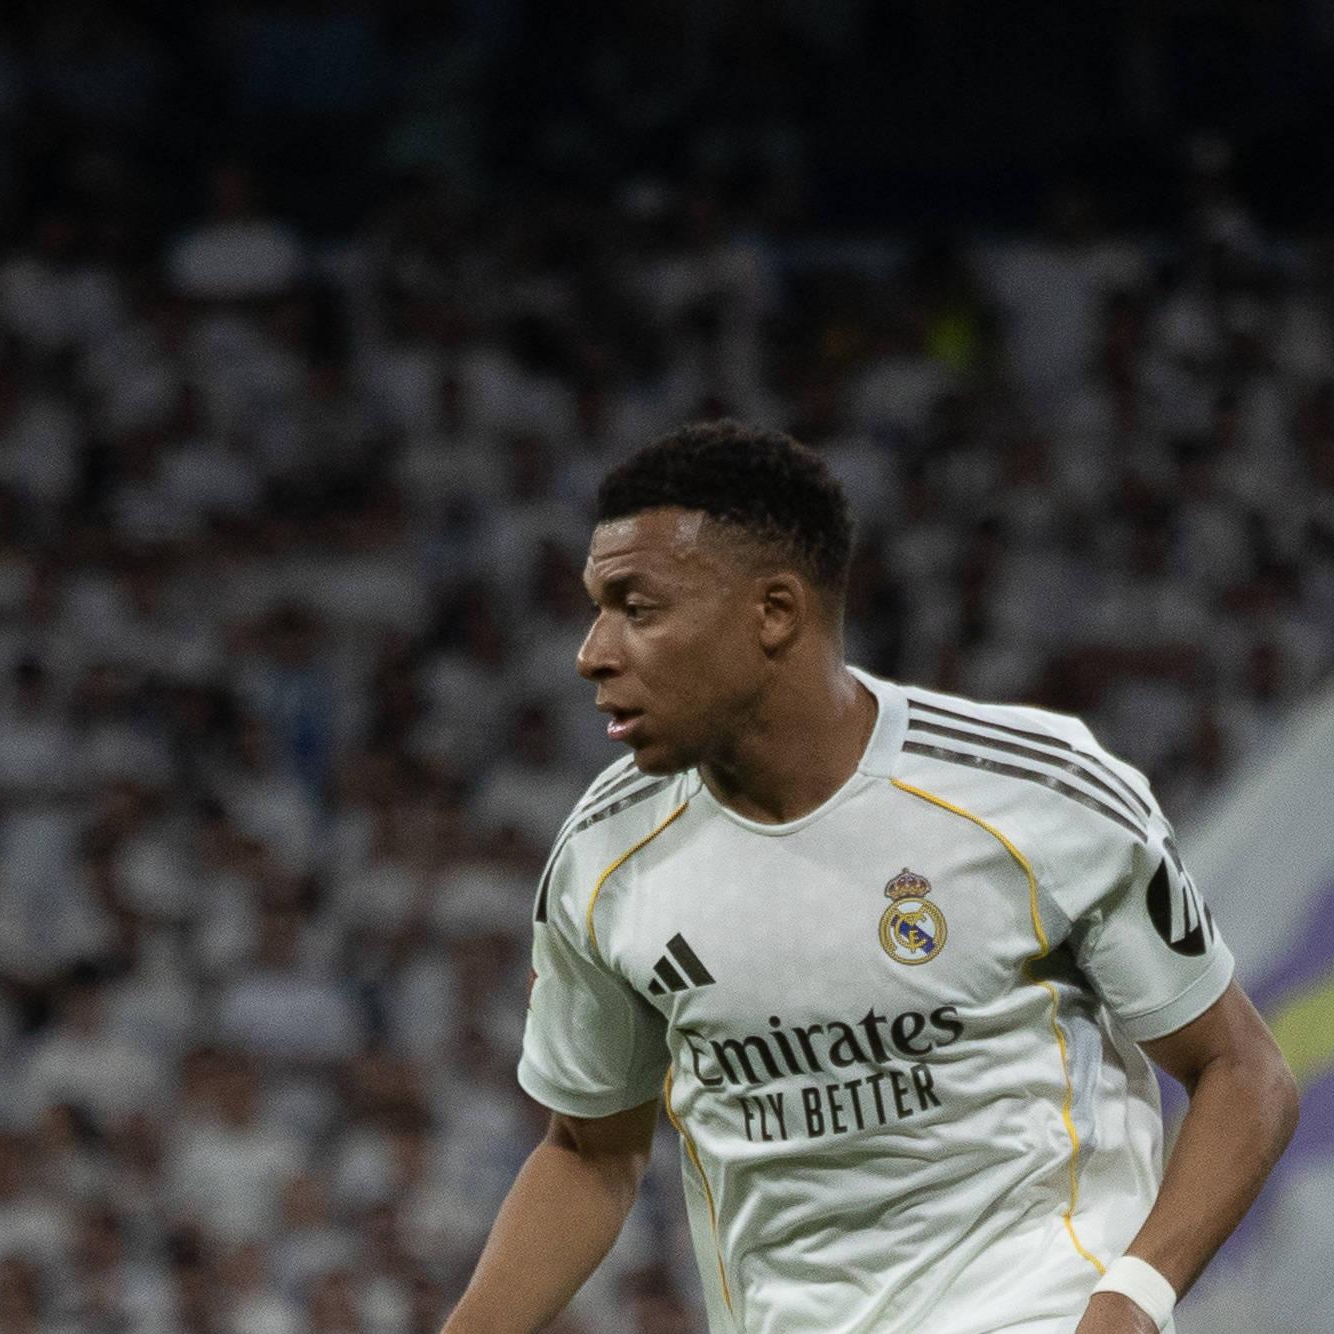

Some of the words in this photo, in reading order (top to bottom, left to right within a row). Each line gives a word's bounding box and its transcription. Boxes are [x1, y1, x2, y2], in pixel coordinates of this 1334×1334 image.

[675, 1006, 965, 1086] Emirates
[737, 1091, 788, 1142] FLY
[802, 1063, 942, 1138] BETTER
